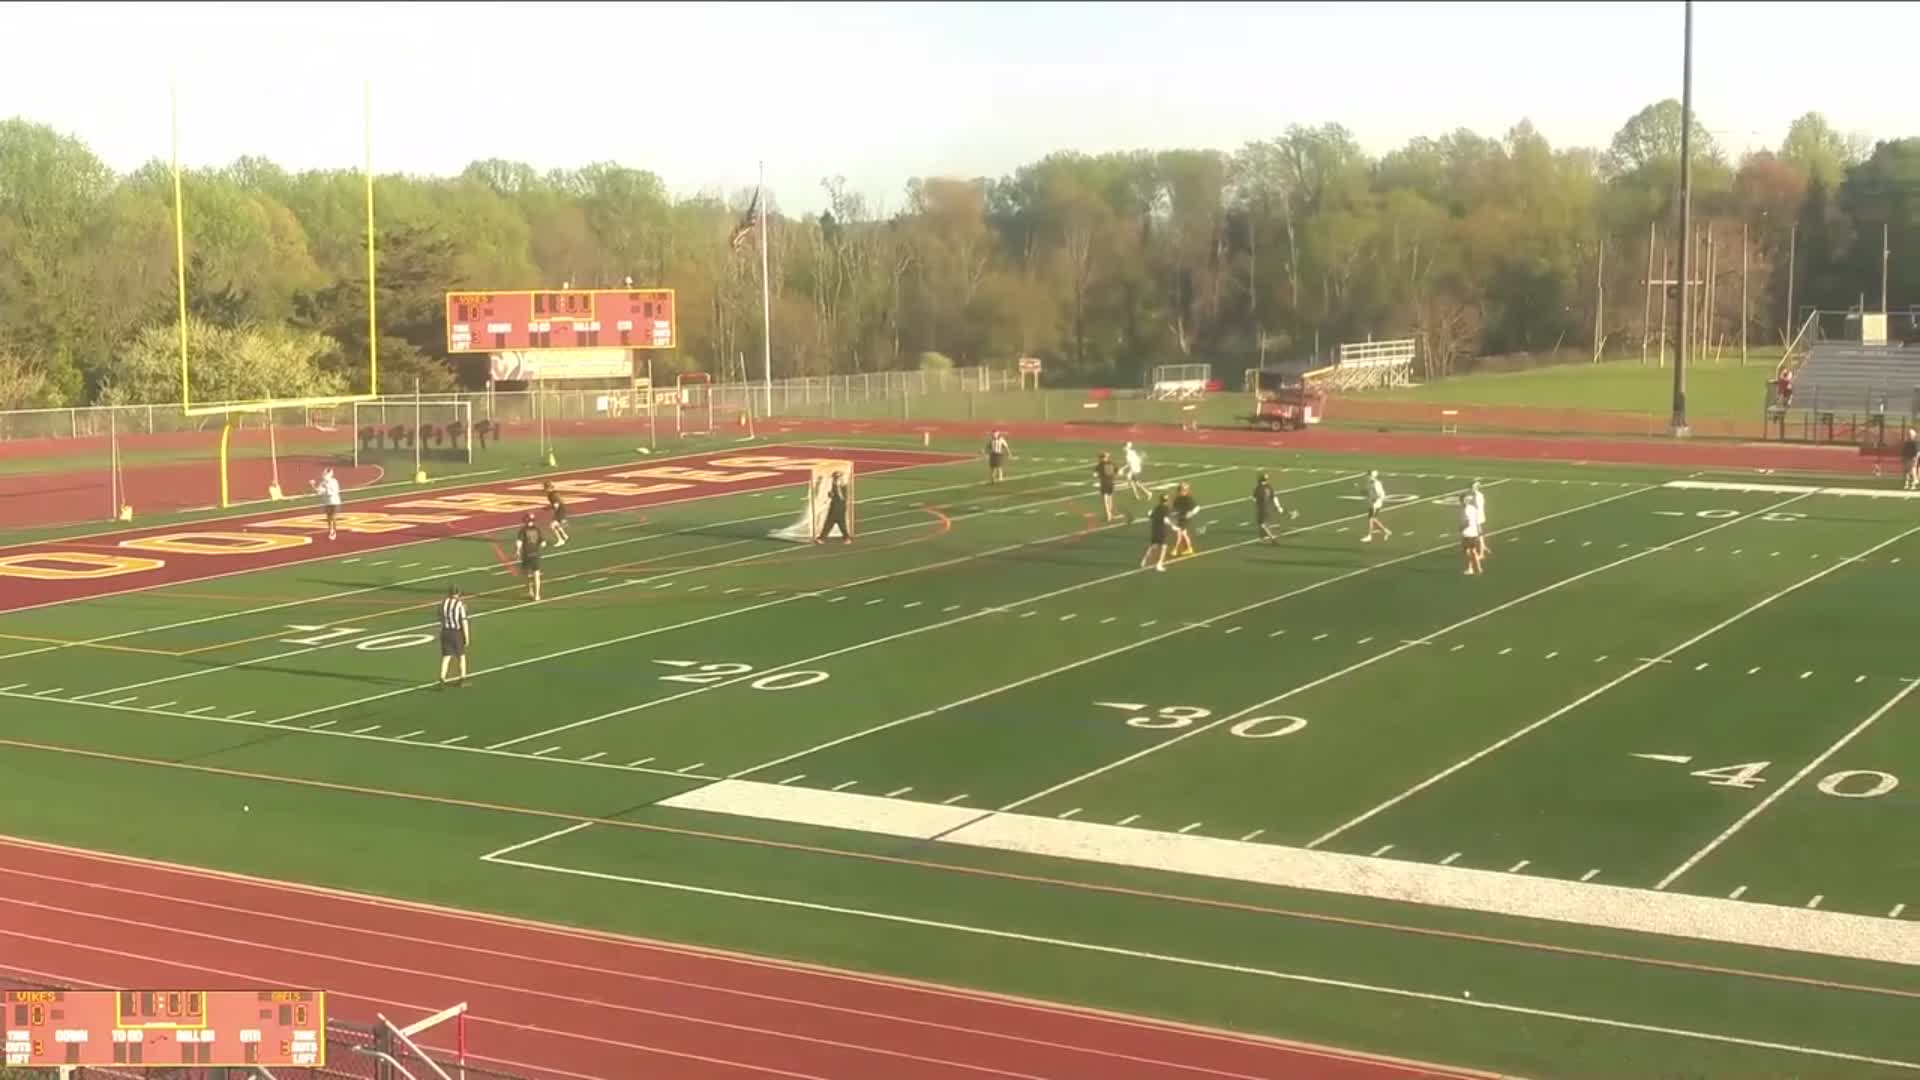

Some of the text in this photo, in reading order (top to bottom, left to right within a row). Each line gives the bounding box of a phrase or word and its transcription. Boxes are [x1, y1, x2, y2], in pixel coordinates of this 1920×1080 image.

[279, 628, 435, 650] 10
[657, 663, 830, 690] 20
[1126, 706, 1308, 737] 30
[1689, 761, 1899, 798] 40
